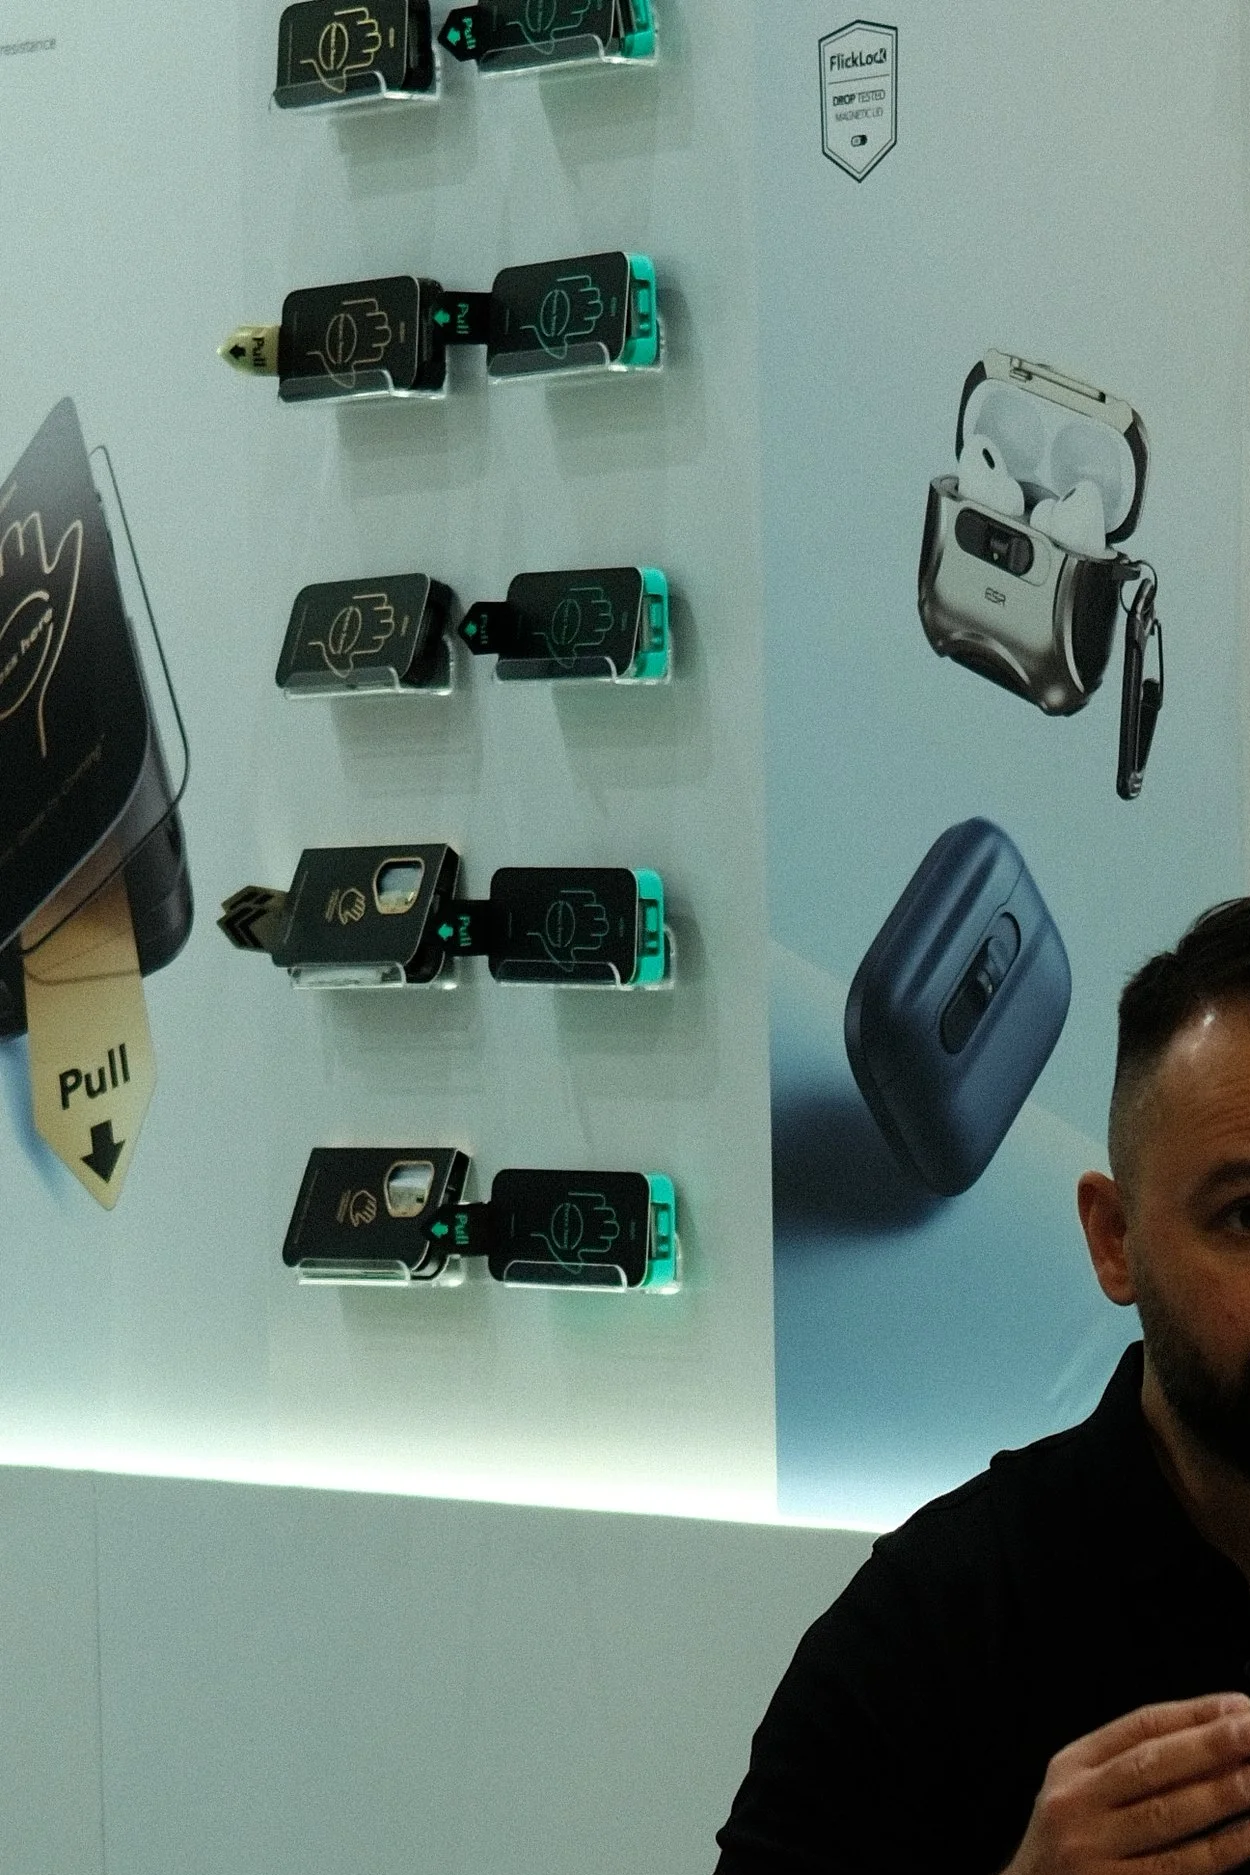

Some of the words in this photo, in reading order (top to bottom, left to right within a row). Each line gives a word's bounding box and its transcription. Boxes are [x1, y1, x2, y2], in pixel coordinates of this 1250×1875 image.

[462, 16, 477, 50] Pull
[832, 92, 857, 107] DROP
[857, 88, 886, 104] TESTED
[456, 303, 470, 335] Pull
[252, 336, 267, 368] Pull
[458, 915, 472, 947] Pull
[58, 1043, 131, 1111] Pull
[455, 1213, 470, 1245] Pull
